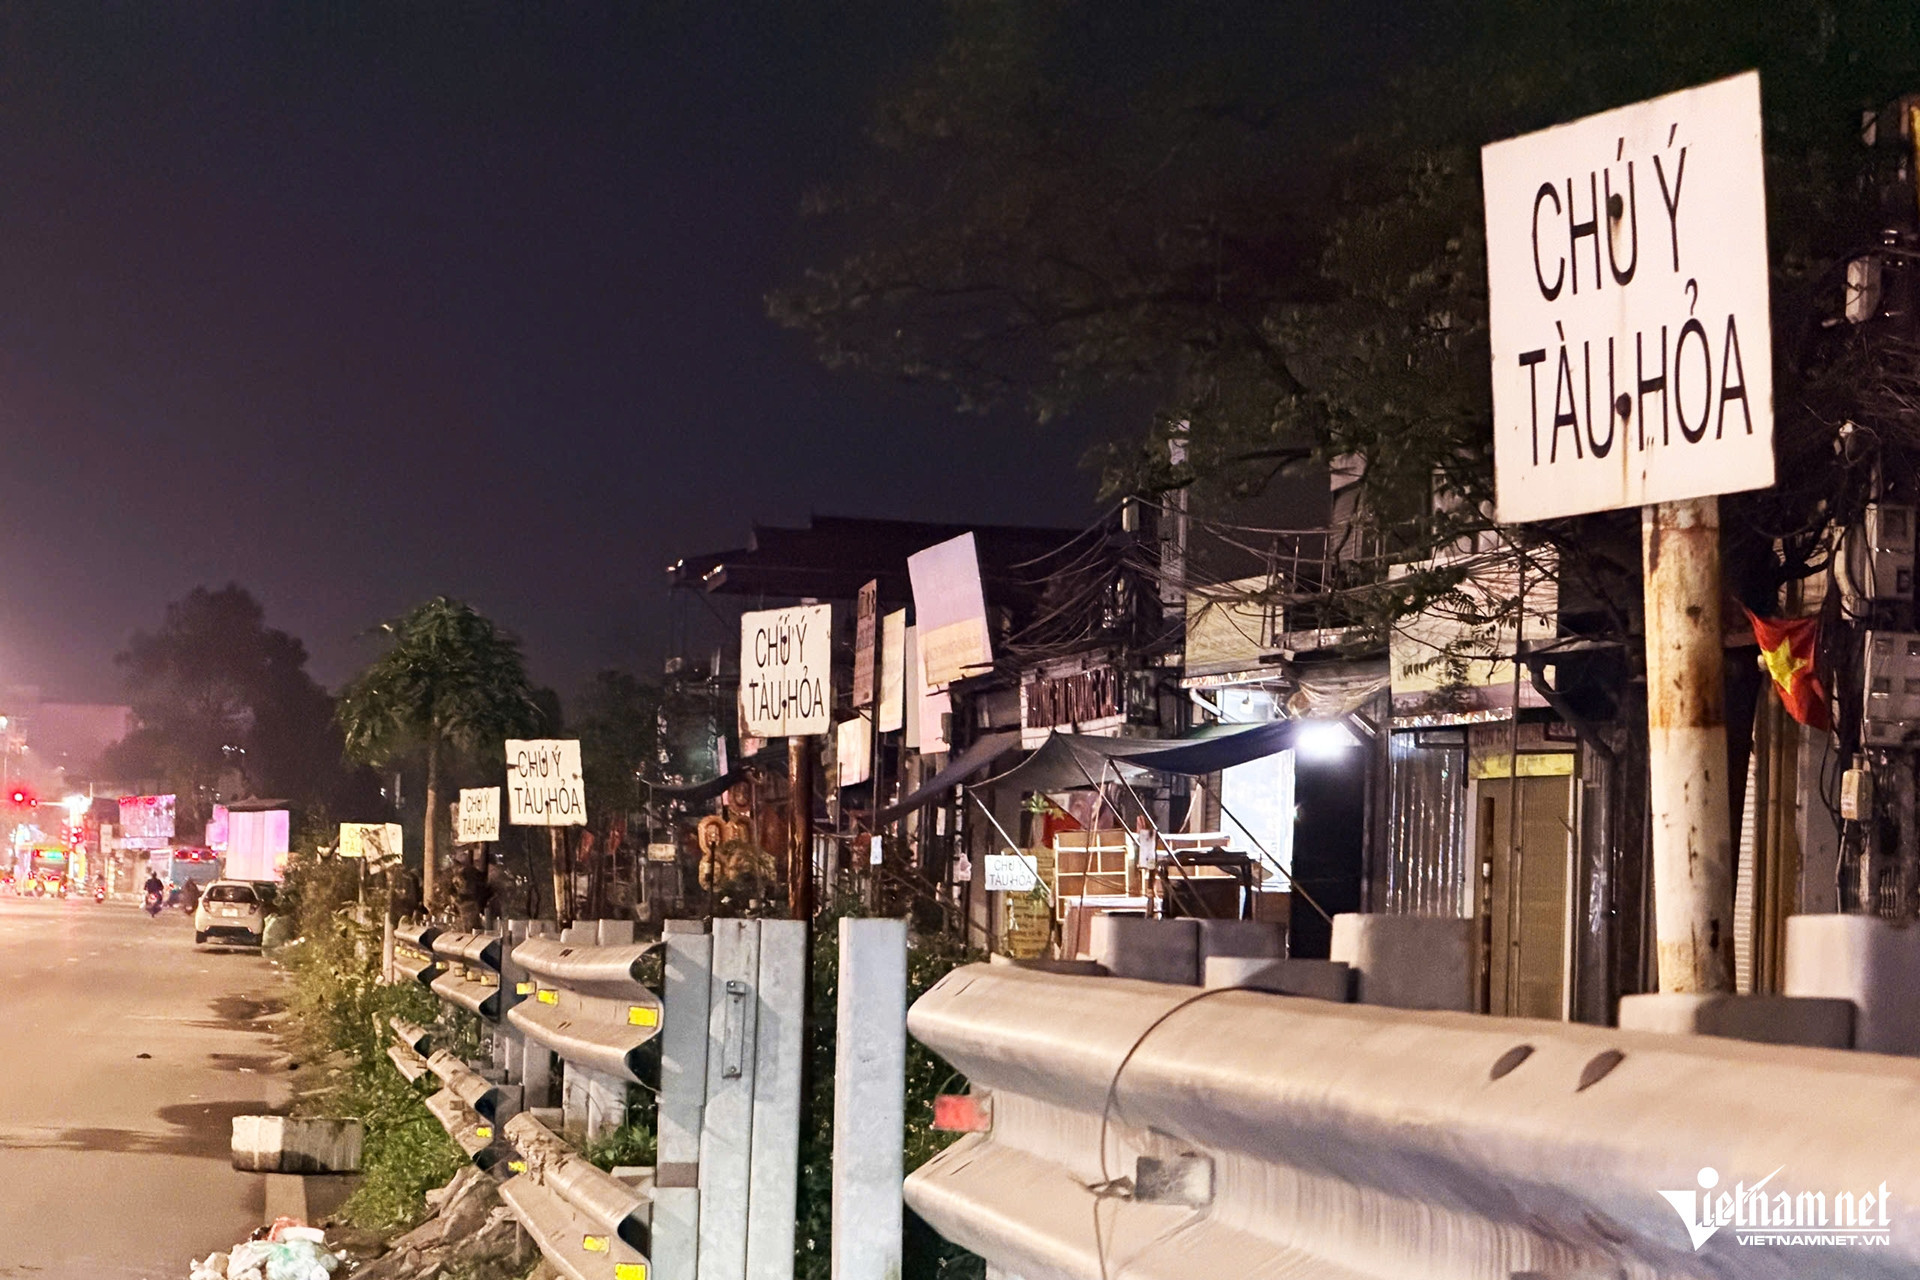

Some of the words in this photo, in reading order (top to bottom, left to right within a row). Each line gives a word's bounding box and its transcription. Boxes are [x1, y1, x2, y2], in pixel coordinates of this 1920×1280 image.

[1531, 137, 1638, 302] CHÚ
[1653, 123, 1688, 273] Ý
[1519, 320, 1615, 467] TÀU
[1636, 278, 1754, 452] HỎA
[796, 615, 807, 663] Ý
[749, 673, 781, 721] TÀU
[788, 665, 824, 719] HỎA
[518, 745, 549, 778] CHÚ
[552, 745, 562, 778] Ý
[514, 781, 544, 815] TÀU
[548, 778, 581, 815] HỎA
